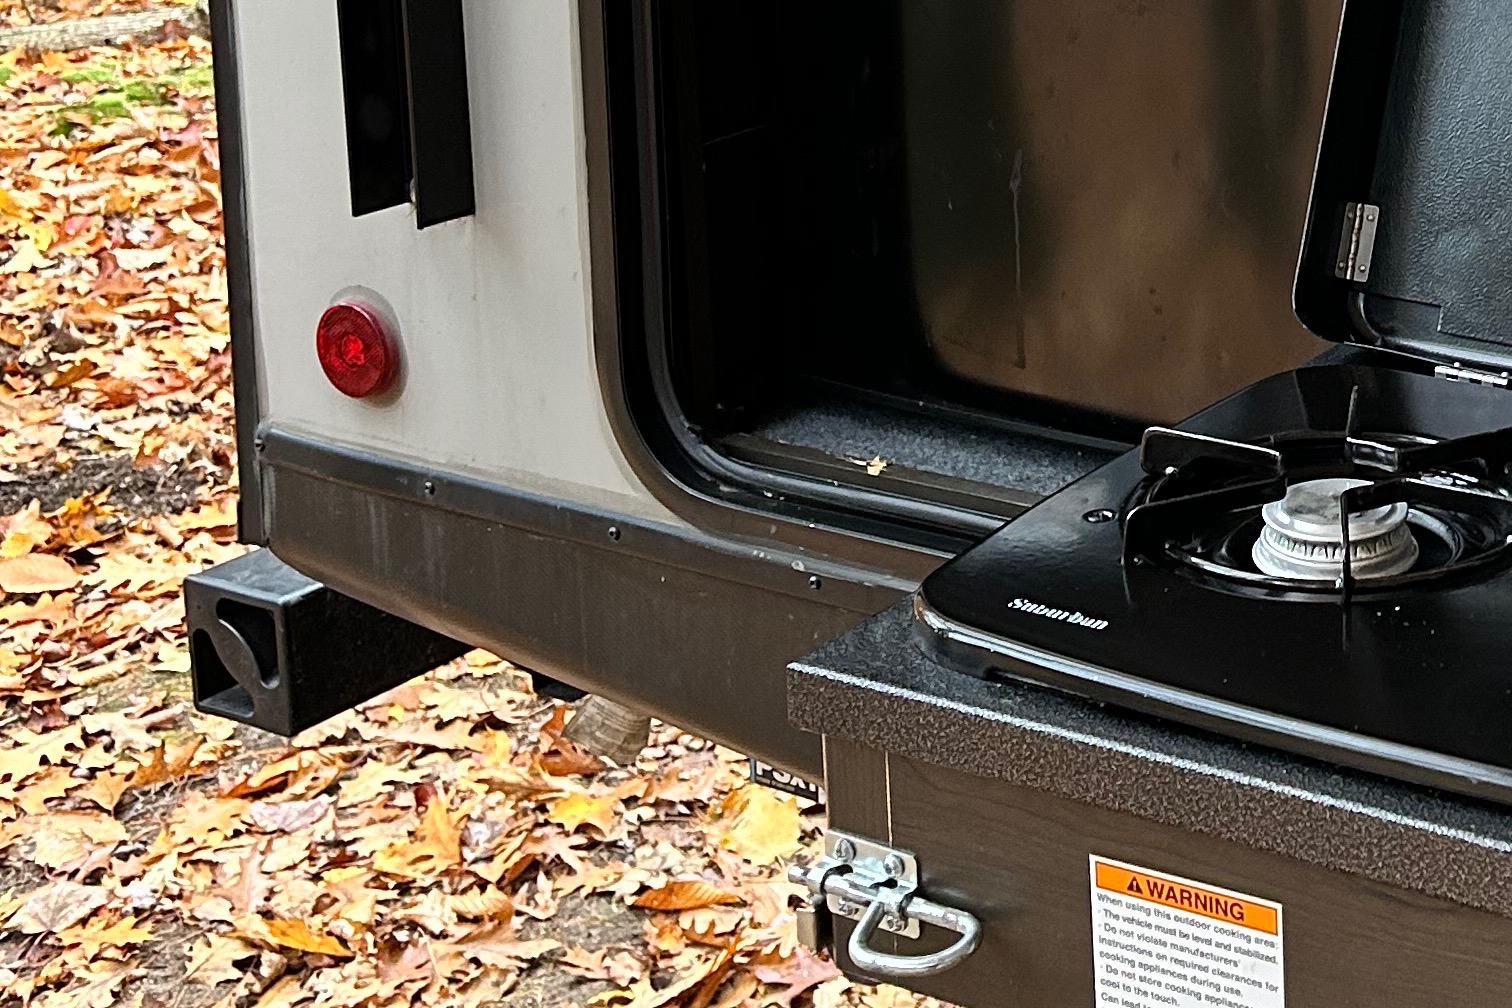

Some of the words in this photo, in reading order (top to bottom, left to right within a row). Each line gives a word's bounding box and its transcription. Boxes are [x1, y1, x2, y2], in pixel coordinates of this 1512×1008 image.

[1097, 893, 1123, 907] When
[1125, 902, 1151, 916] using
[1154, 908, 1171, 920] this
[1174, 914, 1211, 930] outdoor
[1214, 926, 1251, 944] cooking
[1146, 879, 1245, 921] WARNING
[1103, 908, 1120, 921] The
[1122, 916, 1152, 929] vehicle
[1154, 925, 1176, 936] must
[1179, 929, 1191, 940] be
[1192, 933, 1212, 946] level
[1215, 941, 1231, 951] and
[1234, 946, 1278, 965] stabilized.
[1104, 922, 1117, 934] Do
[1120, 929, 1134, 939] not
[1137, 933, 1168, 948] violate
[1099, 951, 1135, 968] cooking
[1138, 962, 1188, 981] appliances
[1190, 976, 1221, 992] during
[1224, 986, 1243, 998] use.
[1100, 978, 1120, 989] cool
[1122, 983, 1131, 992] to
[1134, 987, 1148, 997] the
[1151, 992, 1180, 1007] touch.
[1106, 964, 1118, 975] Do
[1121, 971, 1136, 980] not
[1139, 975, 1162, 987] store
[1164, 983, 1202, 1001] cooking
[1156, 953, 1167, 961] on
[1170, 956, 1209, 973] required
[1212, 968, 1262, 988] clearances
[1265, 982, 1279, 993] for
[1101, 992, 1119, 1004] Can
